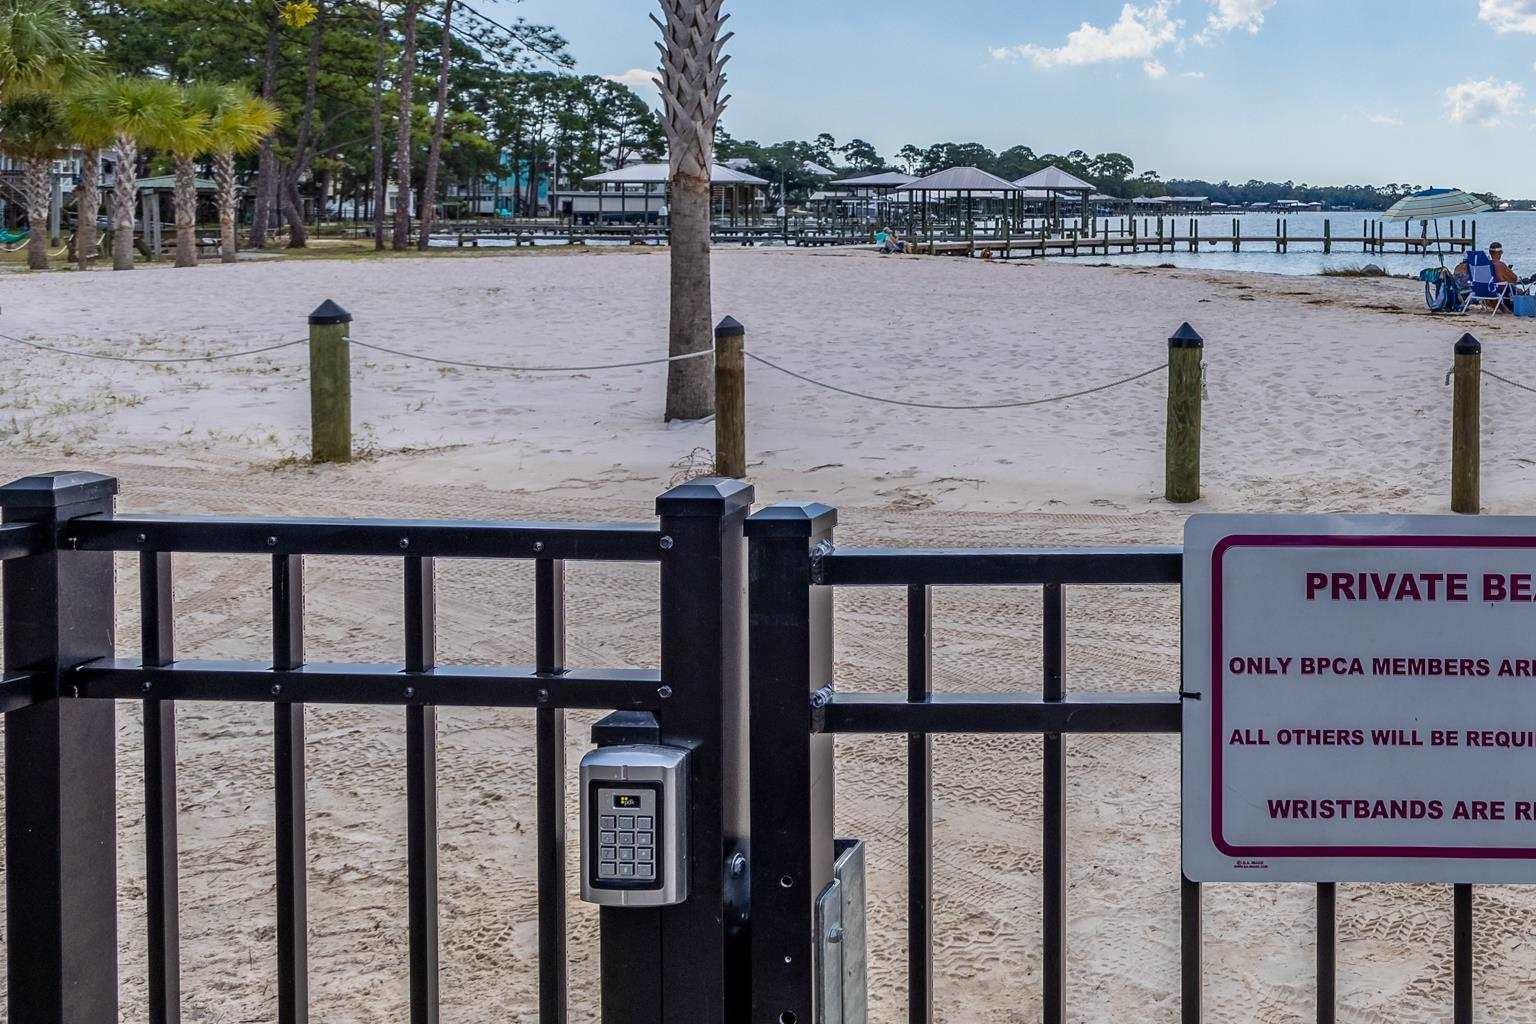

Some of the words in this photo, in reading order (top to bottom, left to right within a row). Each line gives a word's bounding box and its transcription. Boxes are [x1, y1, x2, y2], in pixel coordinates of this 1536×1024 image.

[1306, 572, 1469, 602] PRIVATE
[1228, 656, 1293, 676] ONLY
[1300, 656, 1365, 676] BPCA
[1372, 656, 1491, 677] MEMBERS
[1229, 728, 1270, 746] ALL
[1276, 728, 1365, 746] OTHERS
[1370, 729, 1424, 747] WILL
[1430, 730, 1459, 747] BE
[1267, 799, 1444, 820] WRISTBANDS
[1451, 800, 1506, 821] ARE
